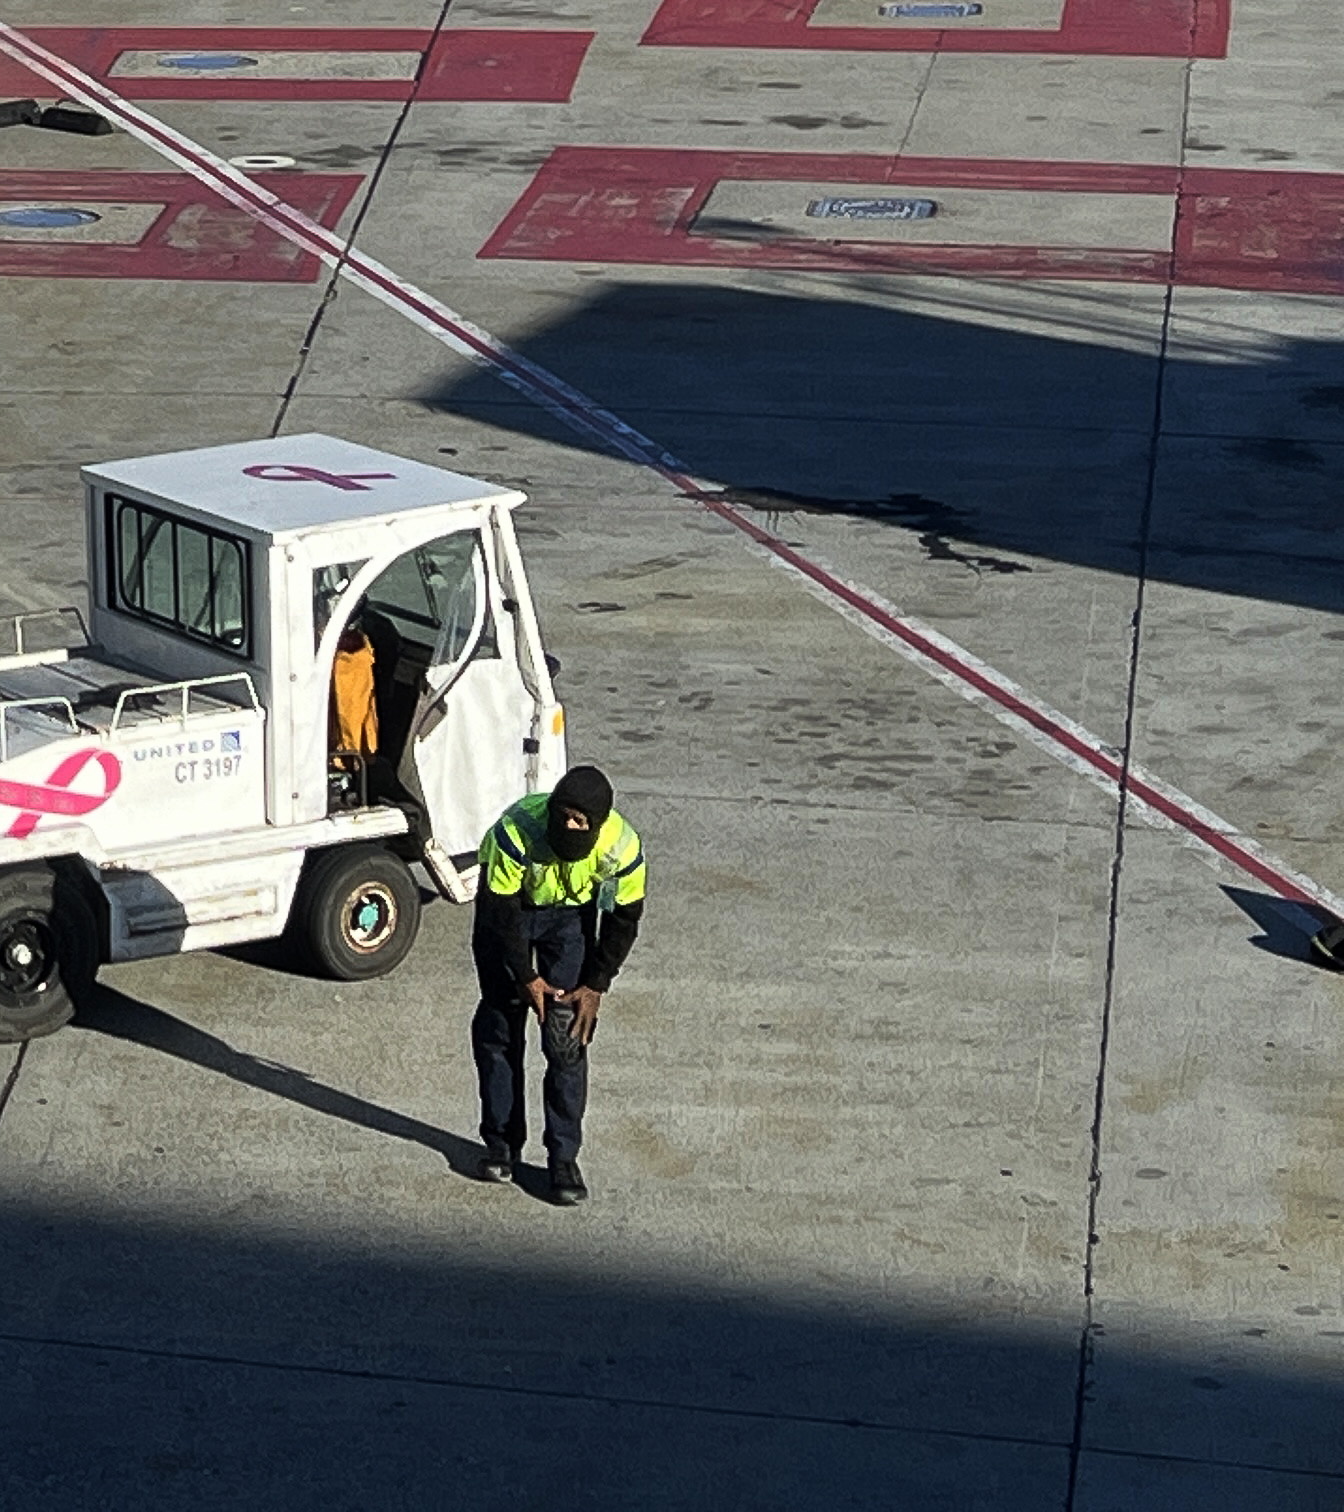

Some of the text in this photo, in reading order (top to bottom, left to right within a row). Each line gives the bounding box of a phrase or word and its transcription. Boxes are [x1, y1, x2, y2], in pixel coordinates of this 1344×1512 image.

[133, 738, 216, 761] UNITED
[174, 754, 242, 784] CT 3197
